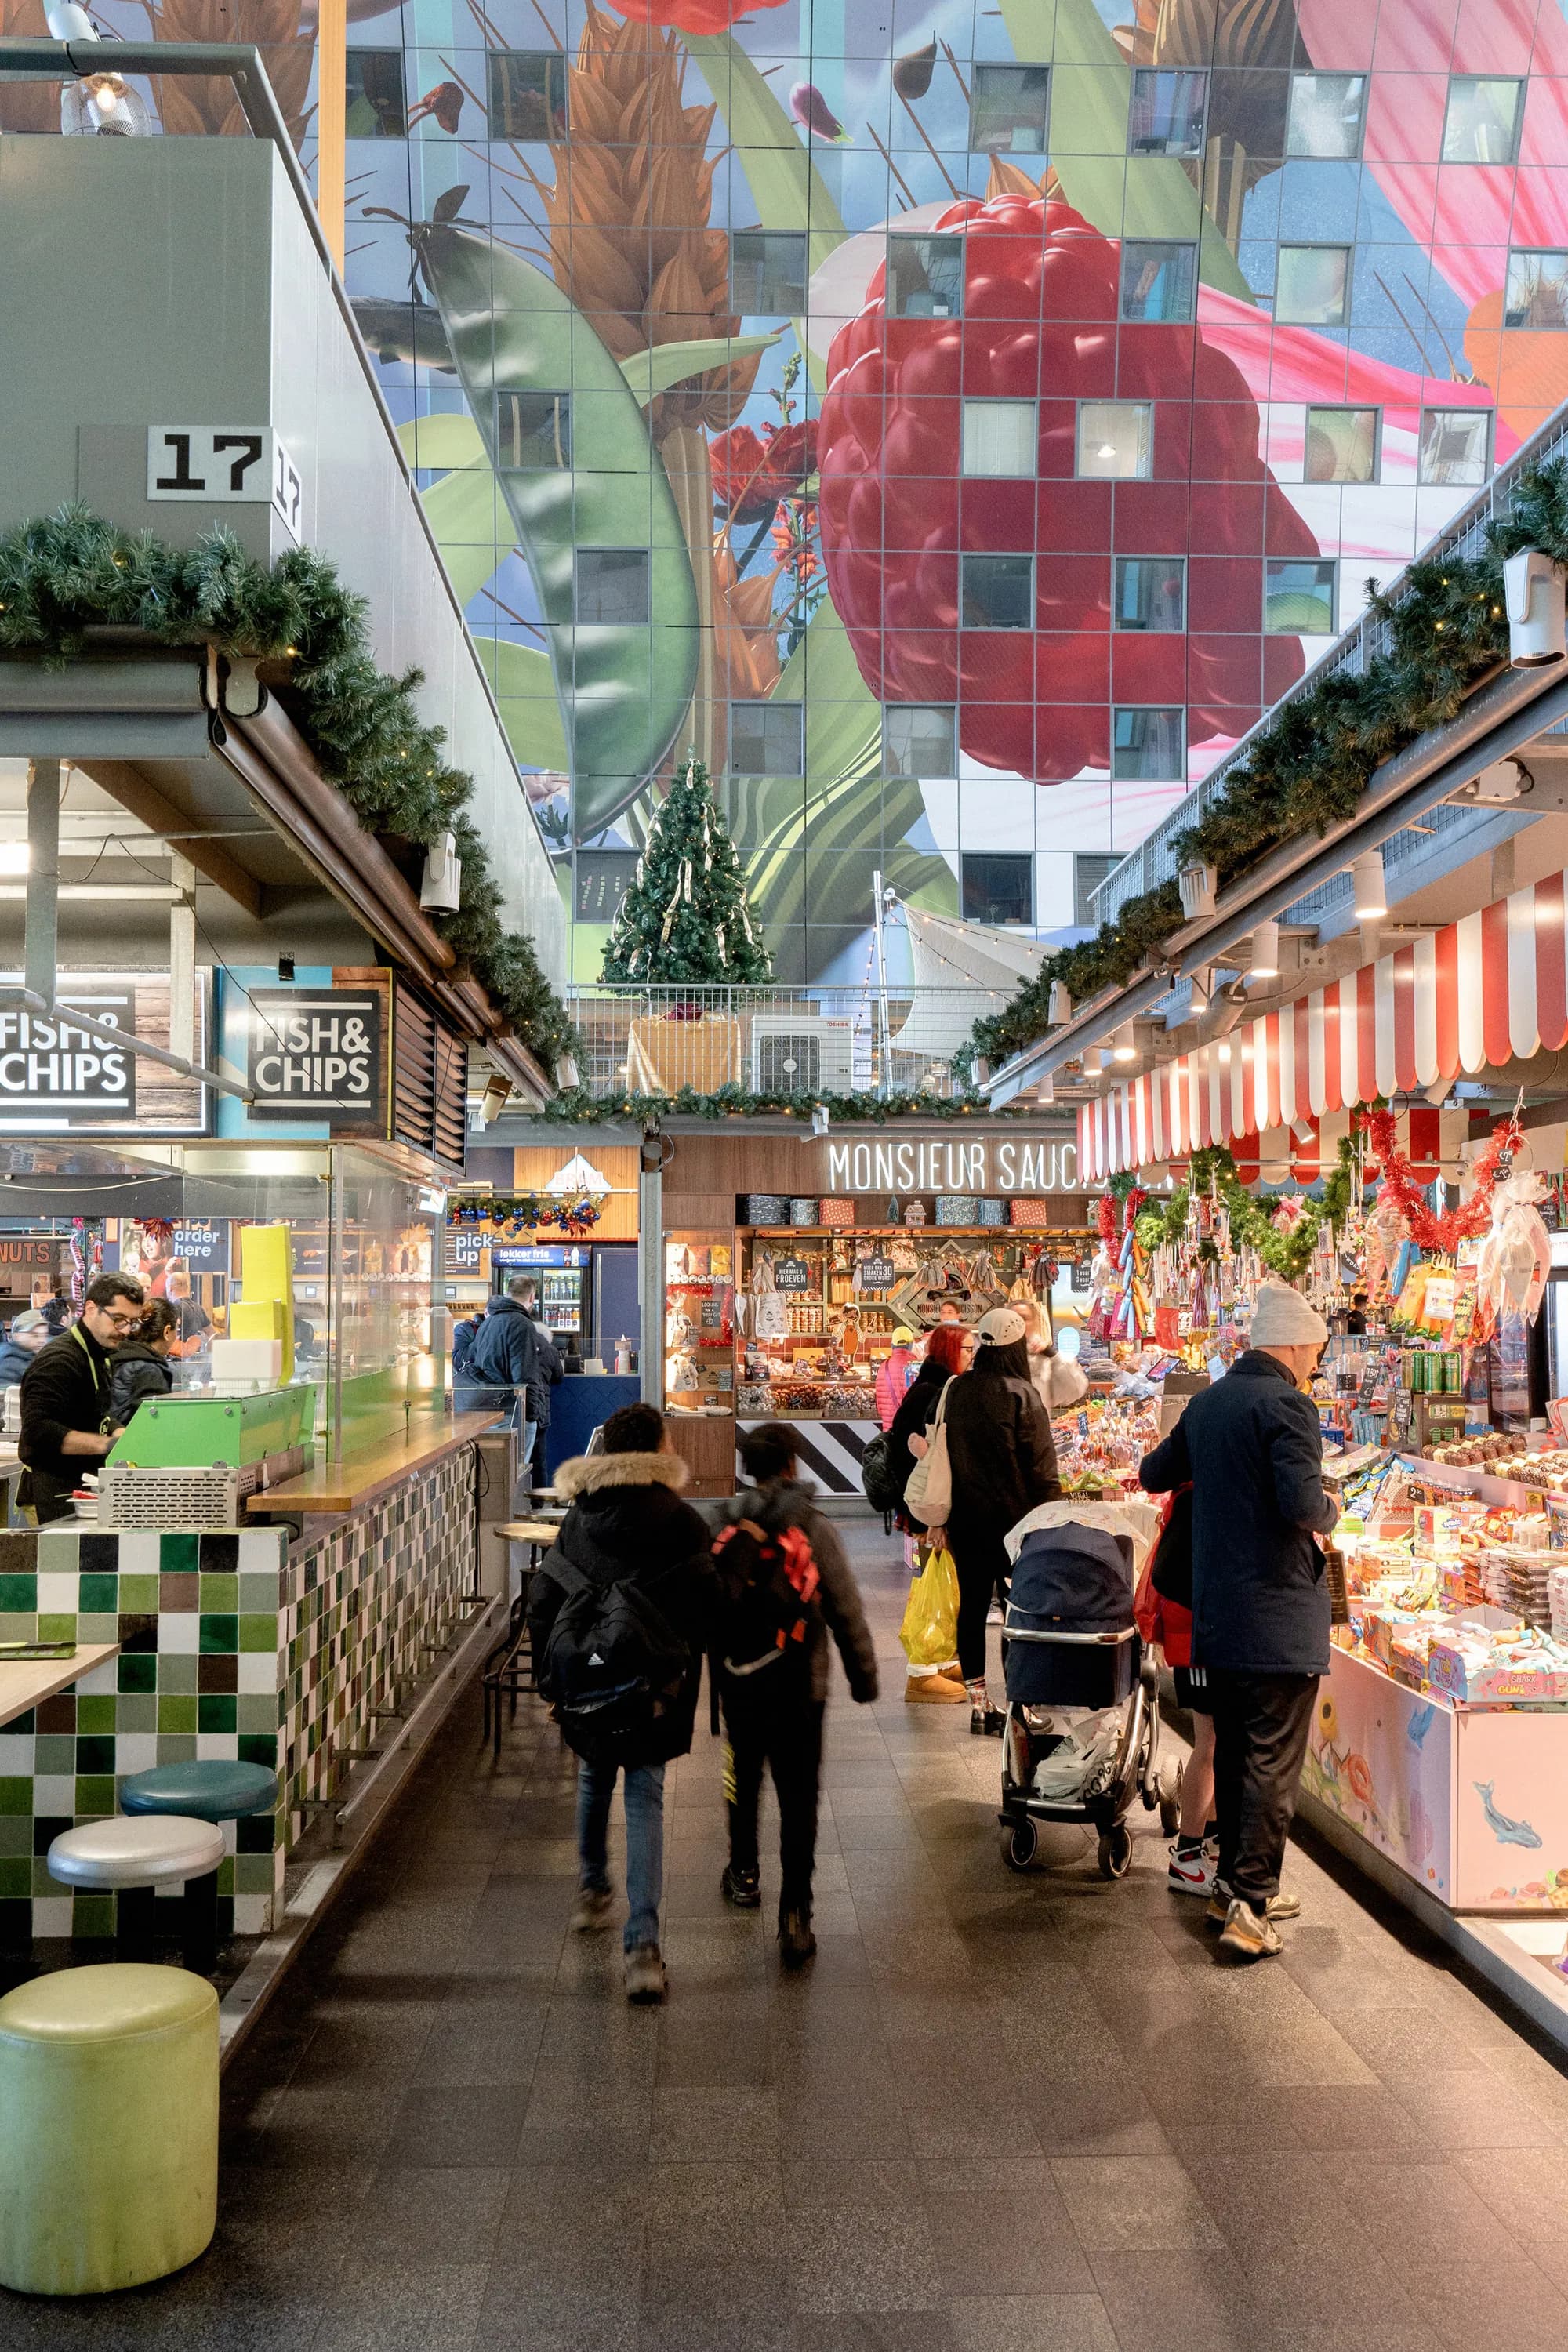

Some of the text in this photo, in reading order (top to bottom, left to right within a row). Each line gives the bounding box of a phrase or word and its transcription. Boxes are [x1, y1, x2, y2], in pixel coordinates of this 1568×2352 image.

[157, 434, 262, 491] 17
[276, 445, 299, 528] 17
[256, 1017, 372, 1054] FISH&
[0, 1053, 127, 1092] CHIPS
[255, 1056, 370, 1094] CHIPS
[829, 1143, 985, 1191] MONSIEUR
[174, 1229, 220, 1243] order
[456, 1232, 502, 1250] pick-
[174, 1243, 212, 1257] here
[456, 1250, 479, 1267] up
[775, 1274, 806, 1283] PROEVEN
[883, 1265, 892, 1276] 30
[1511, 1675, 1537, 1683] SHARK
